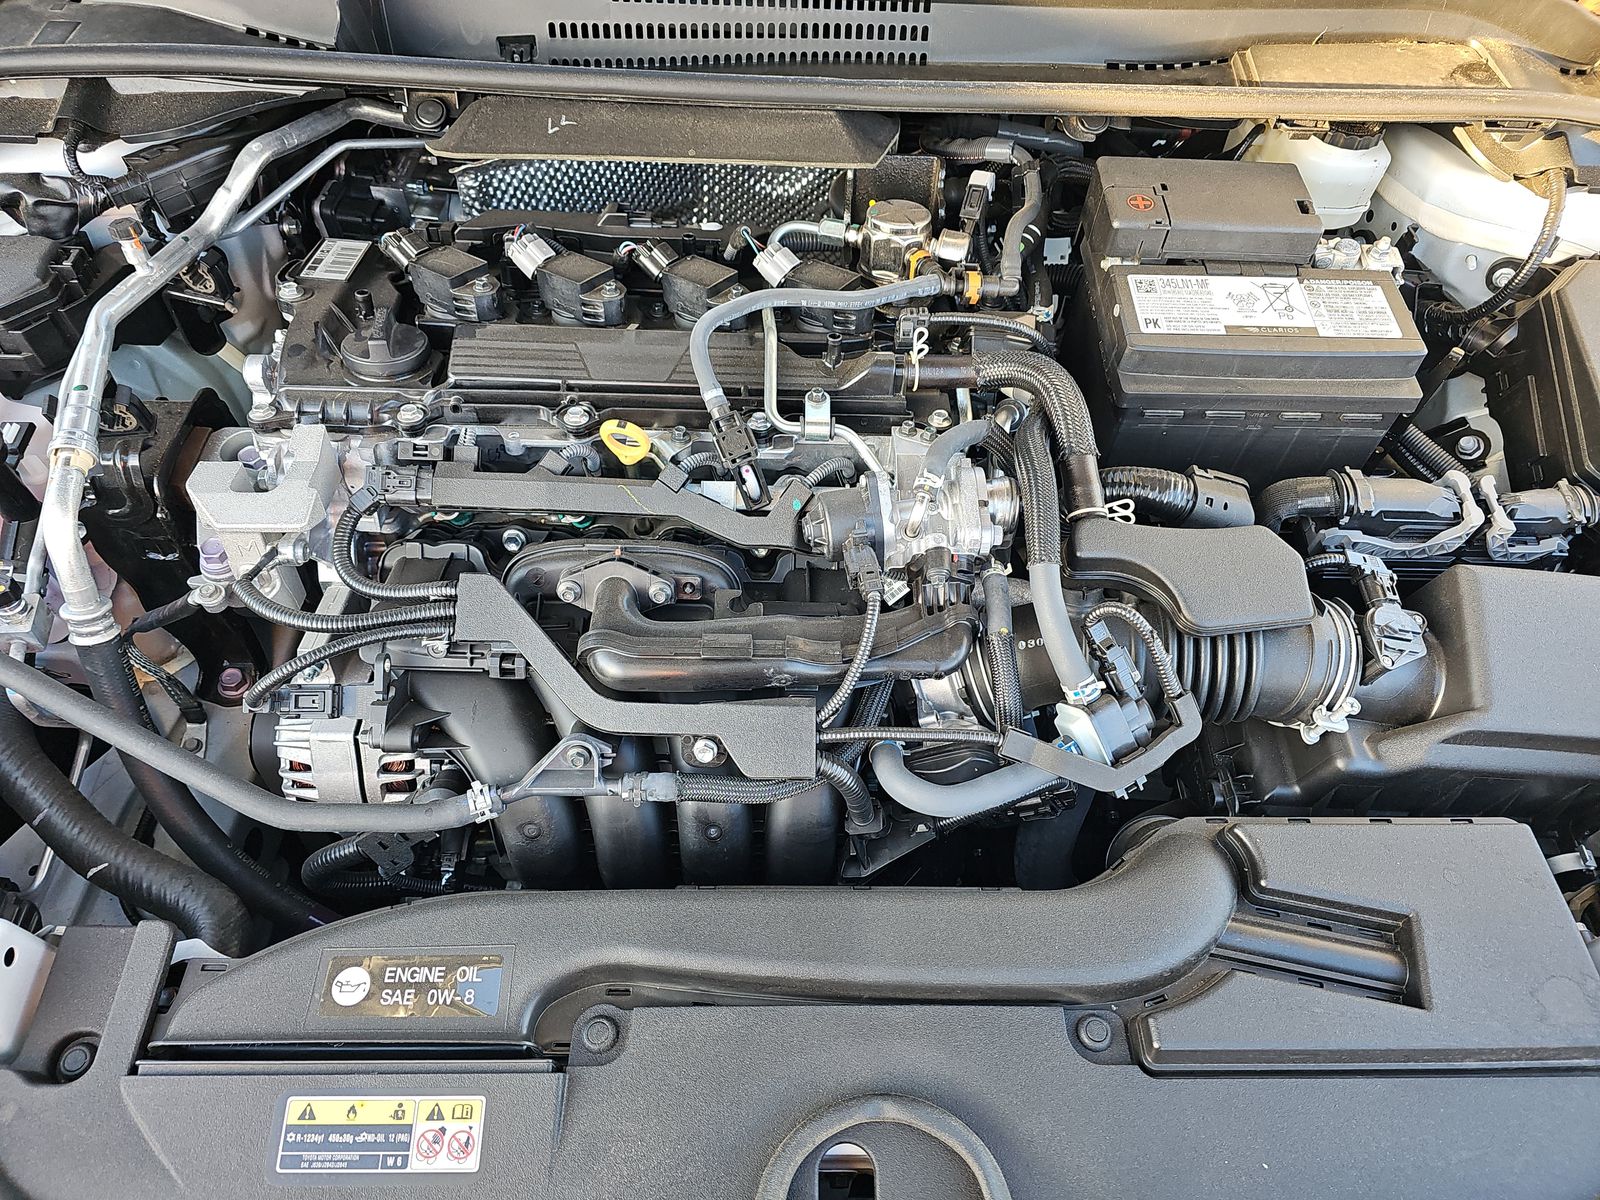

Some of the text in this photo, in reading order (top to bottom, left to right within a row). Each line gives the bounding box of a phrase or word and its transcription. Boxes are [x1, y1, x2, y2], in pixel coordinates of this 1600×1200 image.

[1159, 278, 1210, 289] 345LN1-MF
[1278, 312, 1295, 321] Pb
[1144, 318, 1161, 329] PK
[1260, 326, 1301, 334] CLARIOS
[384, 965, 483, 983] ENGINE OIL
[380, 988, 475, 1006] SAE 0W-8
[296, 1133, 324, 1144] R-1234yf
[389, 1133, 395, 1142] 12
[395, 1133, 410, 1144] (PAG)
[387, 1157, 402, 1167] W 6
